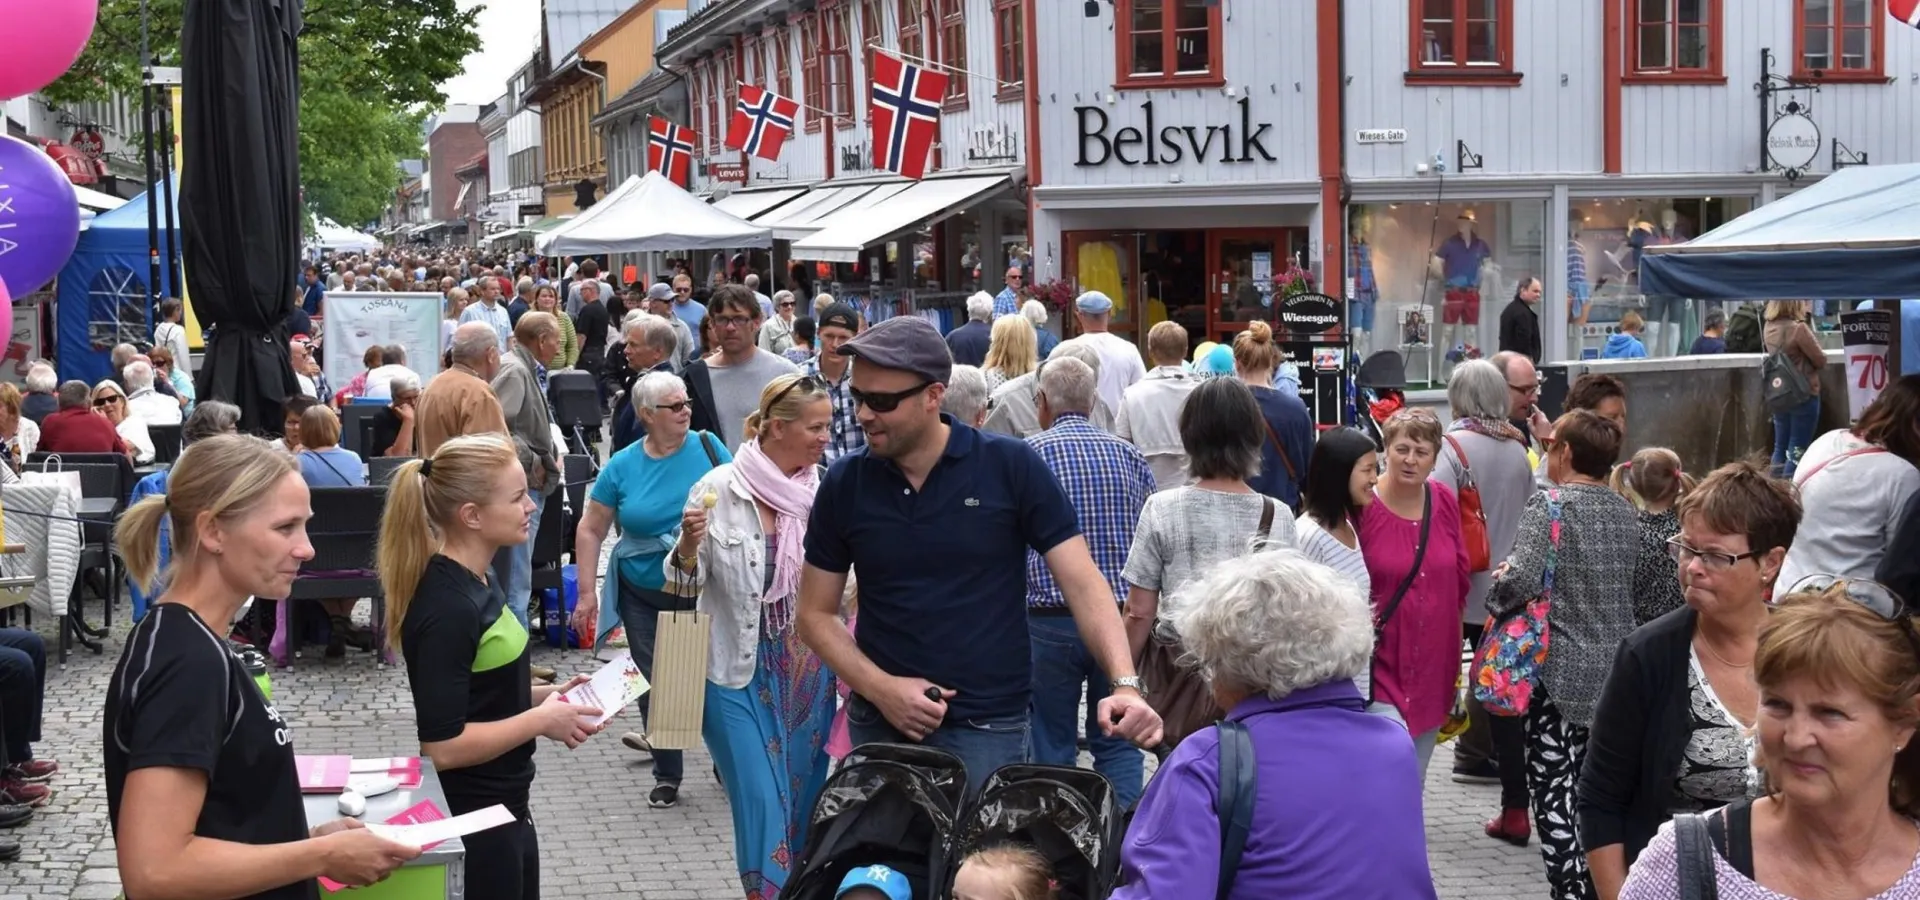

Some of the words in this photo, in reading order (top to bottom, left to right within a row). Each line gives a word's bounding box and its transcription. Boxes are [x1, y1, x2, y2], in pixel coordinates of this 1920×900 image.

[1074, 97, 1277, 166] Belsvik
[1359, 132, 1385, 140] Wieses
[1388, 130, 1404, 140] Gate
[360, 299, 409, 313] TOSCANA
[1286, 294, 1326, 307] VELKOMMEN
[1283, 312, 1339, 324] Wiesesgate
